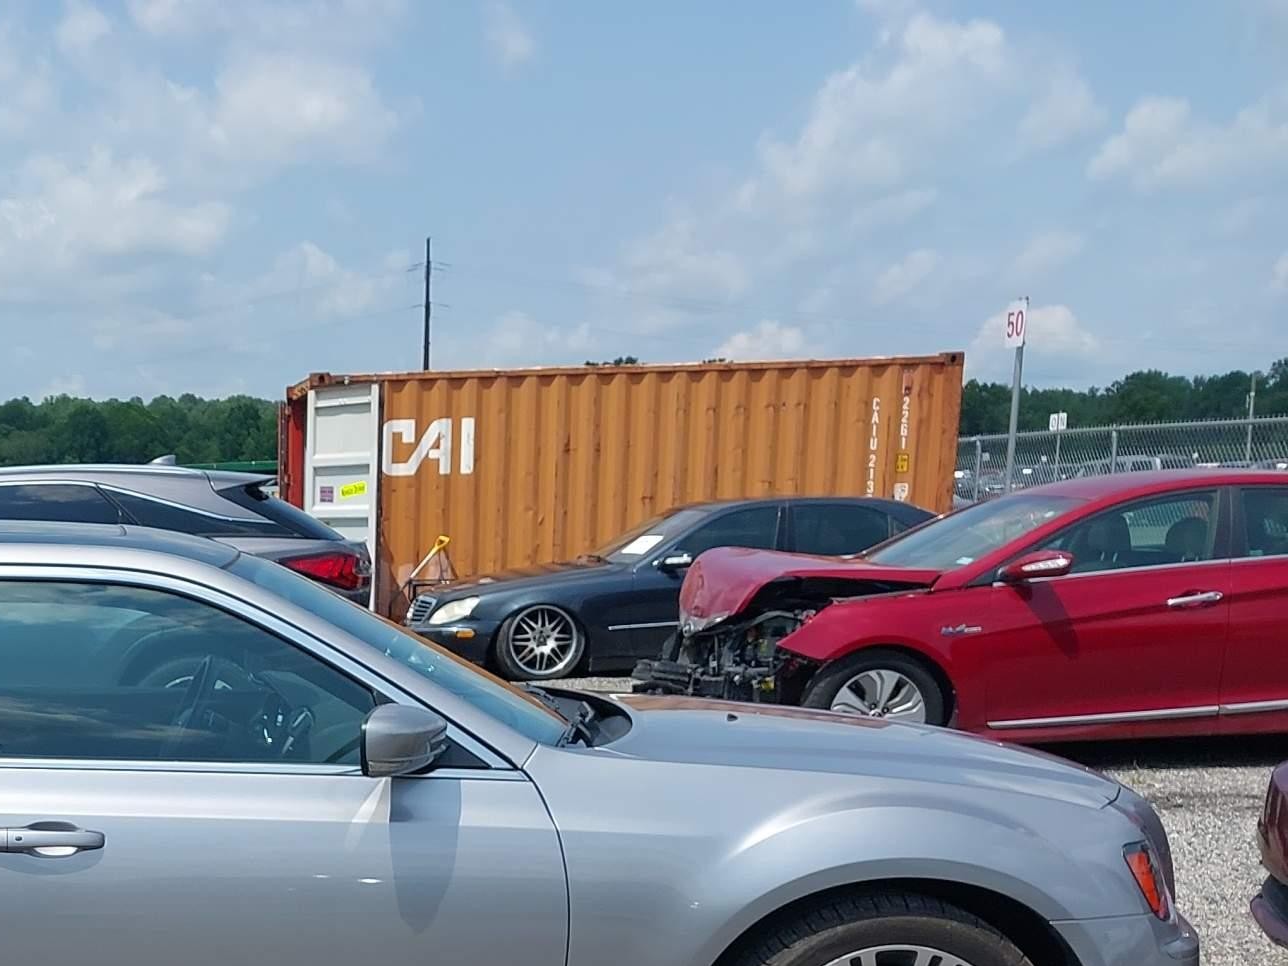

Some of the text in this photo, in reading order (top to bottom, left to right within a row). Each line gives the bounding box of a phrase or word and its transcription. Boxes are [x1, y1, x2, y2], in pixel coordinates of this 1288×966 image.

[1007, 310, 1024, 338] 50
[382, 417, 475, 476] CAI
[866, 397, 880, 498] CAIU 213
